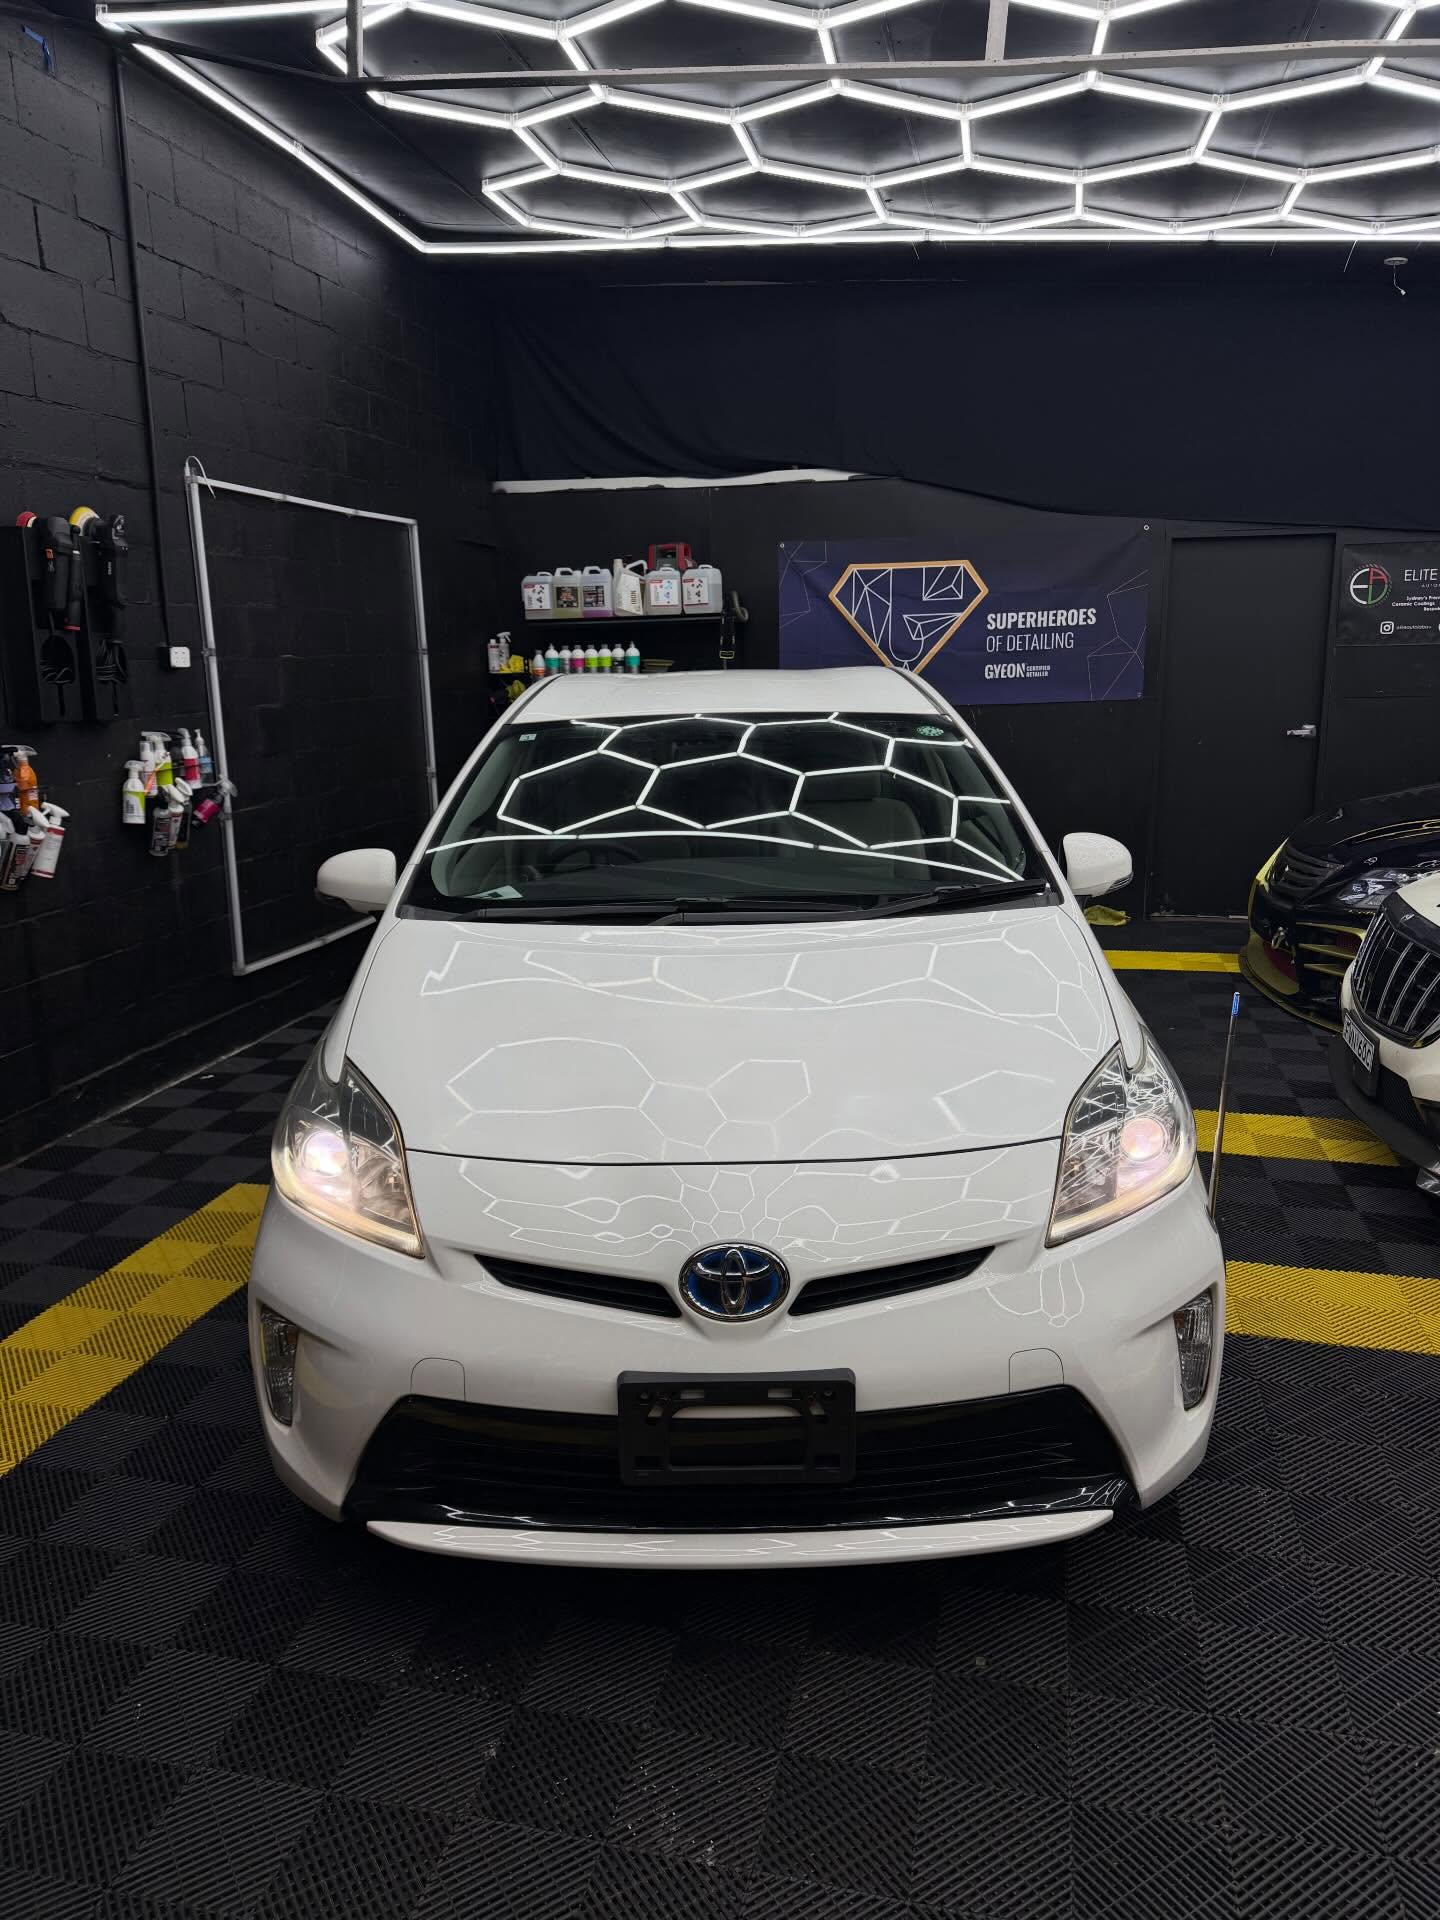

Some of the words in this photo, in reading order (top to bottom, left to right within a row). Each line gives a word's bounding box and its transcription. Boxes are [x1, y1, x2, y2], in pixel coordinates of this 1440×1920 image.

[1404, 568, 1438, 581] ELITE
[987, 608, 1096, 629] SUPERHEROES
[986, 635, 1002, 652] OF
[1006, 632, 1074, 651] DETAILING
[985, 663, 1026, 679] GYEON
